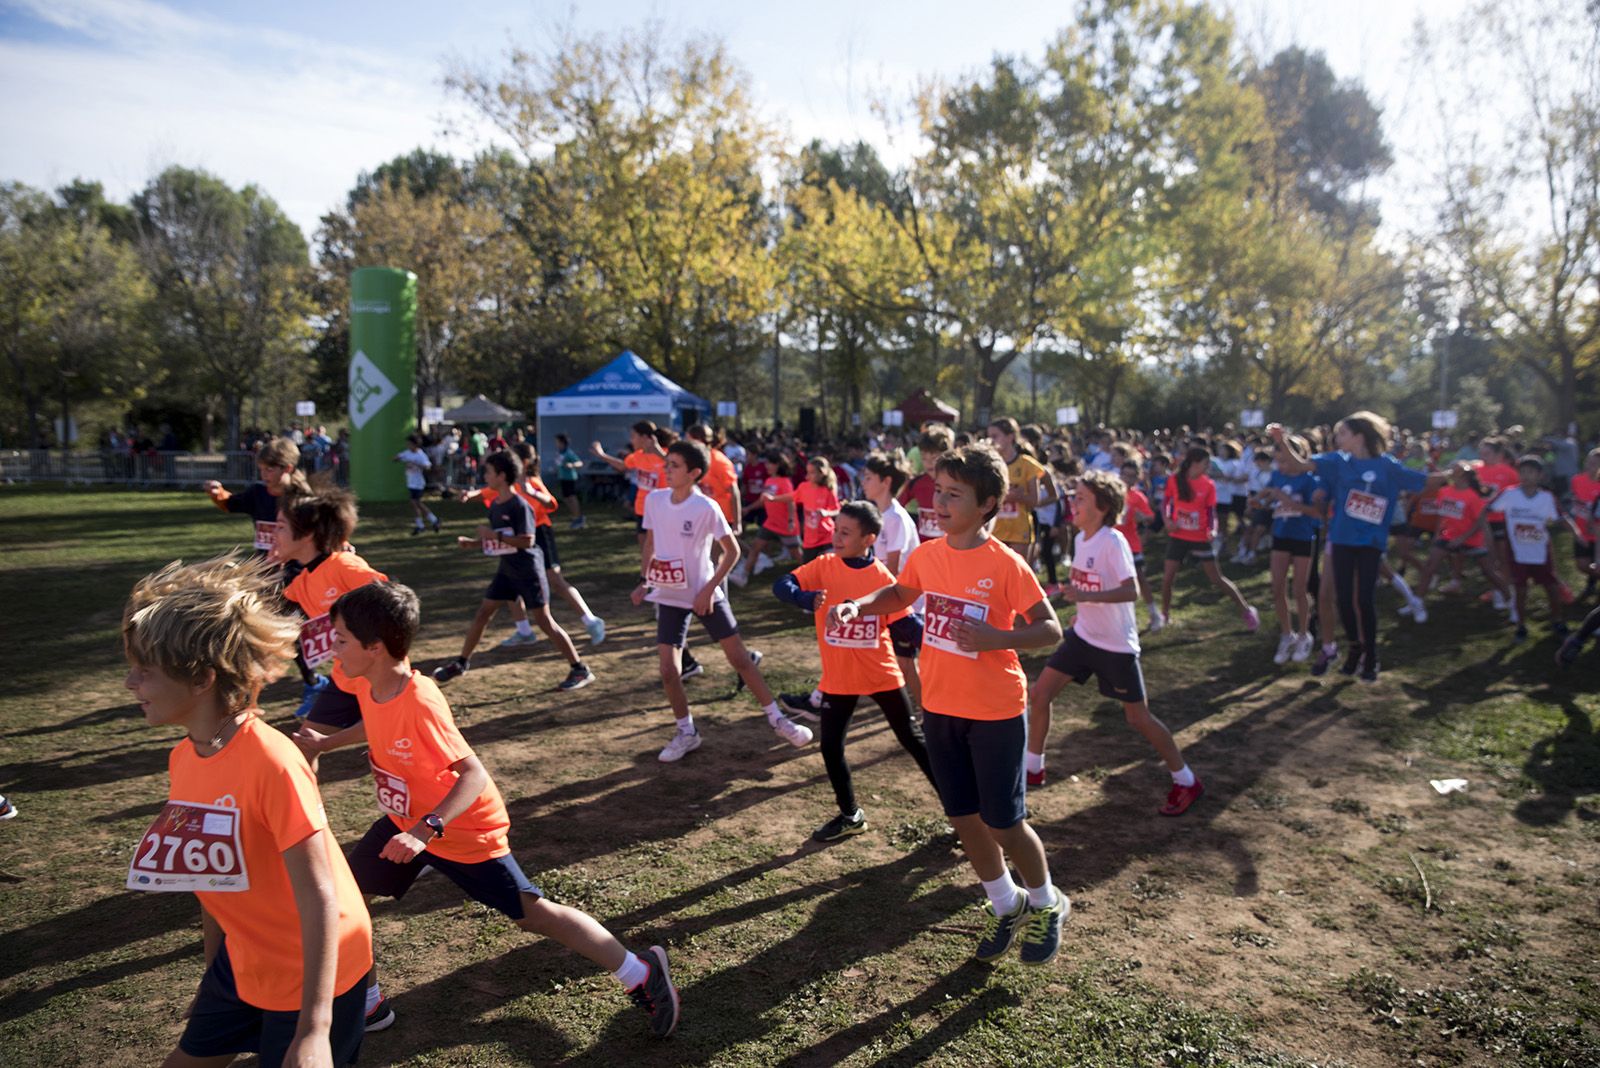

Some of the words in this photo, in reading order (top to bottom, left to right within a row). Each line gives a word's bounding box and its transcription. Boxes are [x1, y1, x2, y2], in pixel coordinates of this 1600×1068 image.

[648, 568, 684, 583] 4219
[828, 622, 876, 640] 2758
[927, 612, 953, 639] 27
[138, 832, 235, 873] 2760
